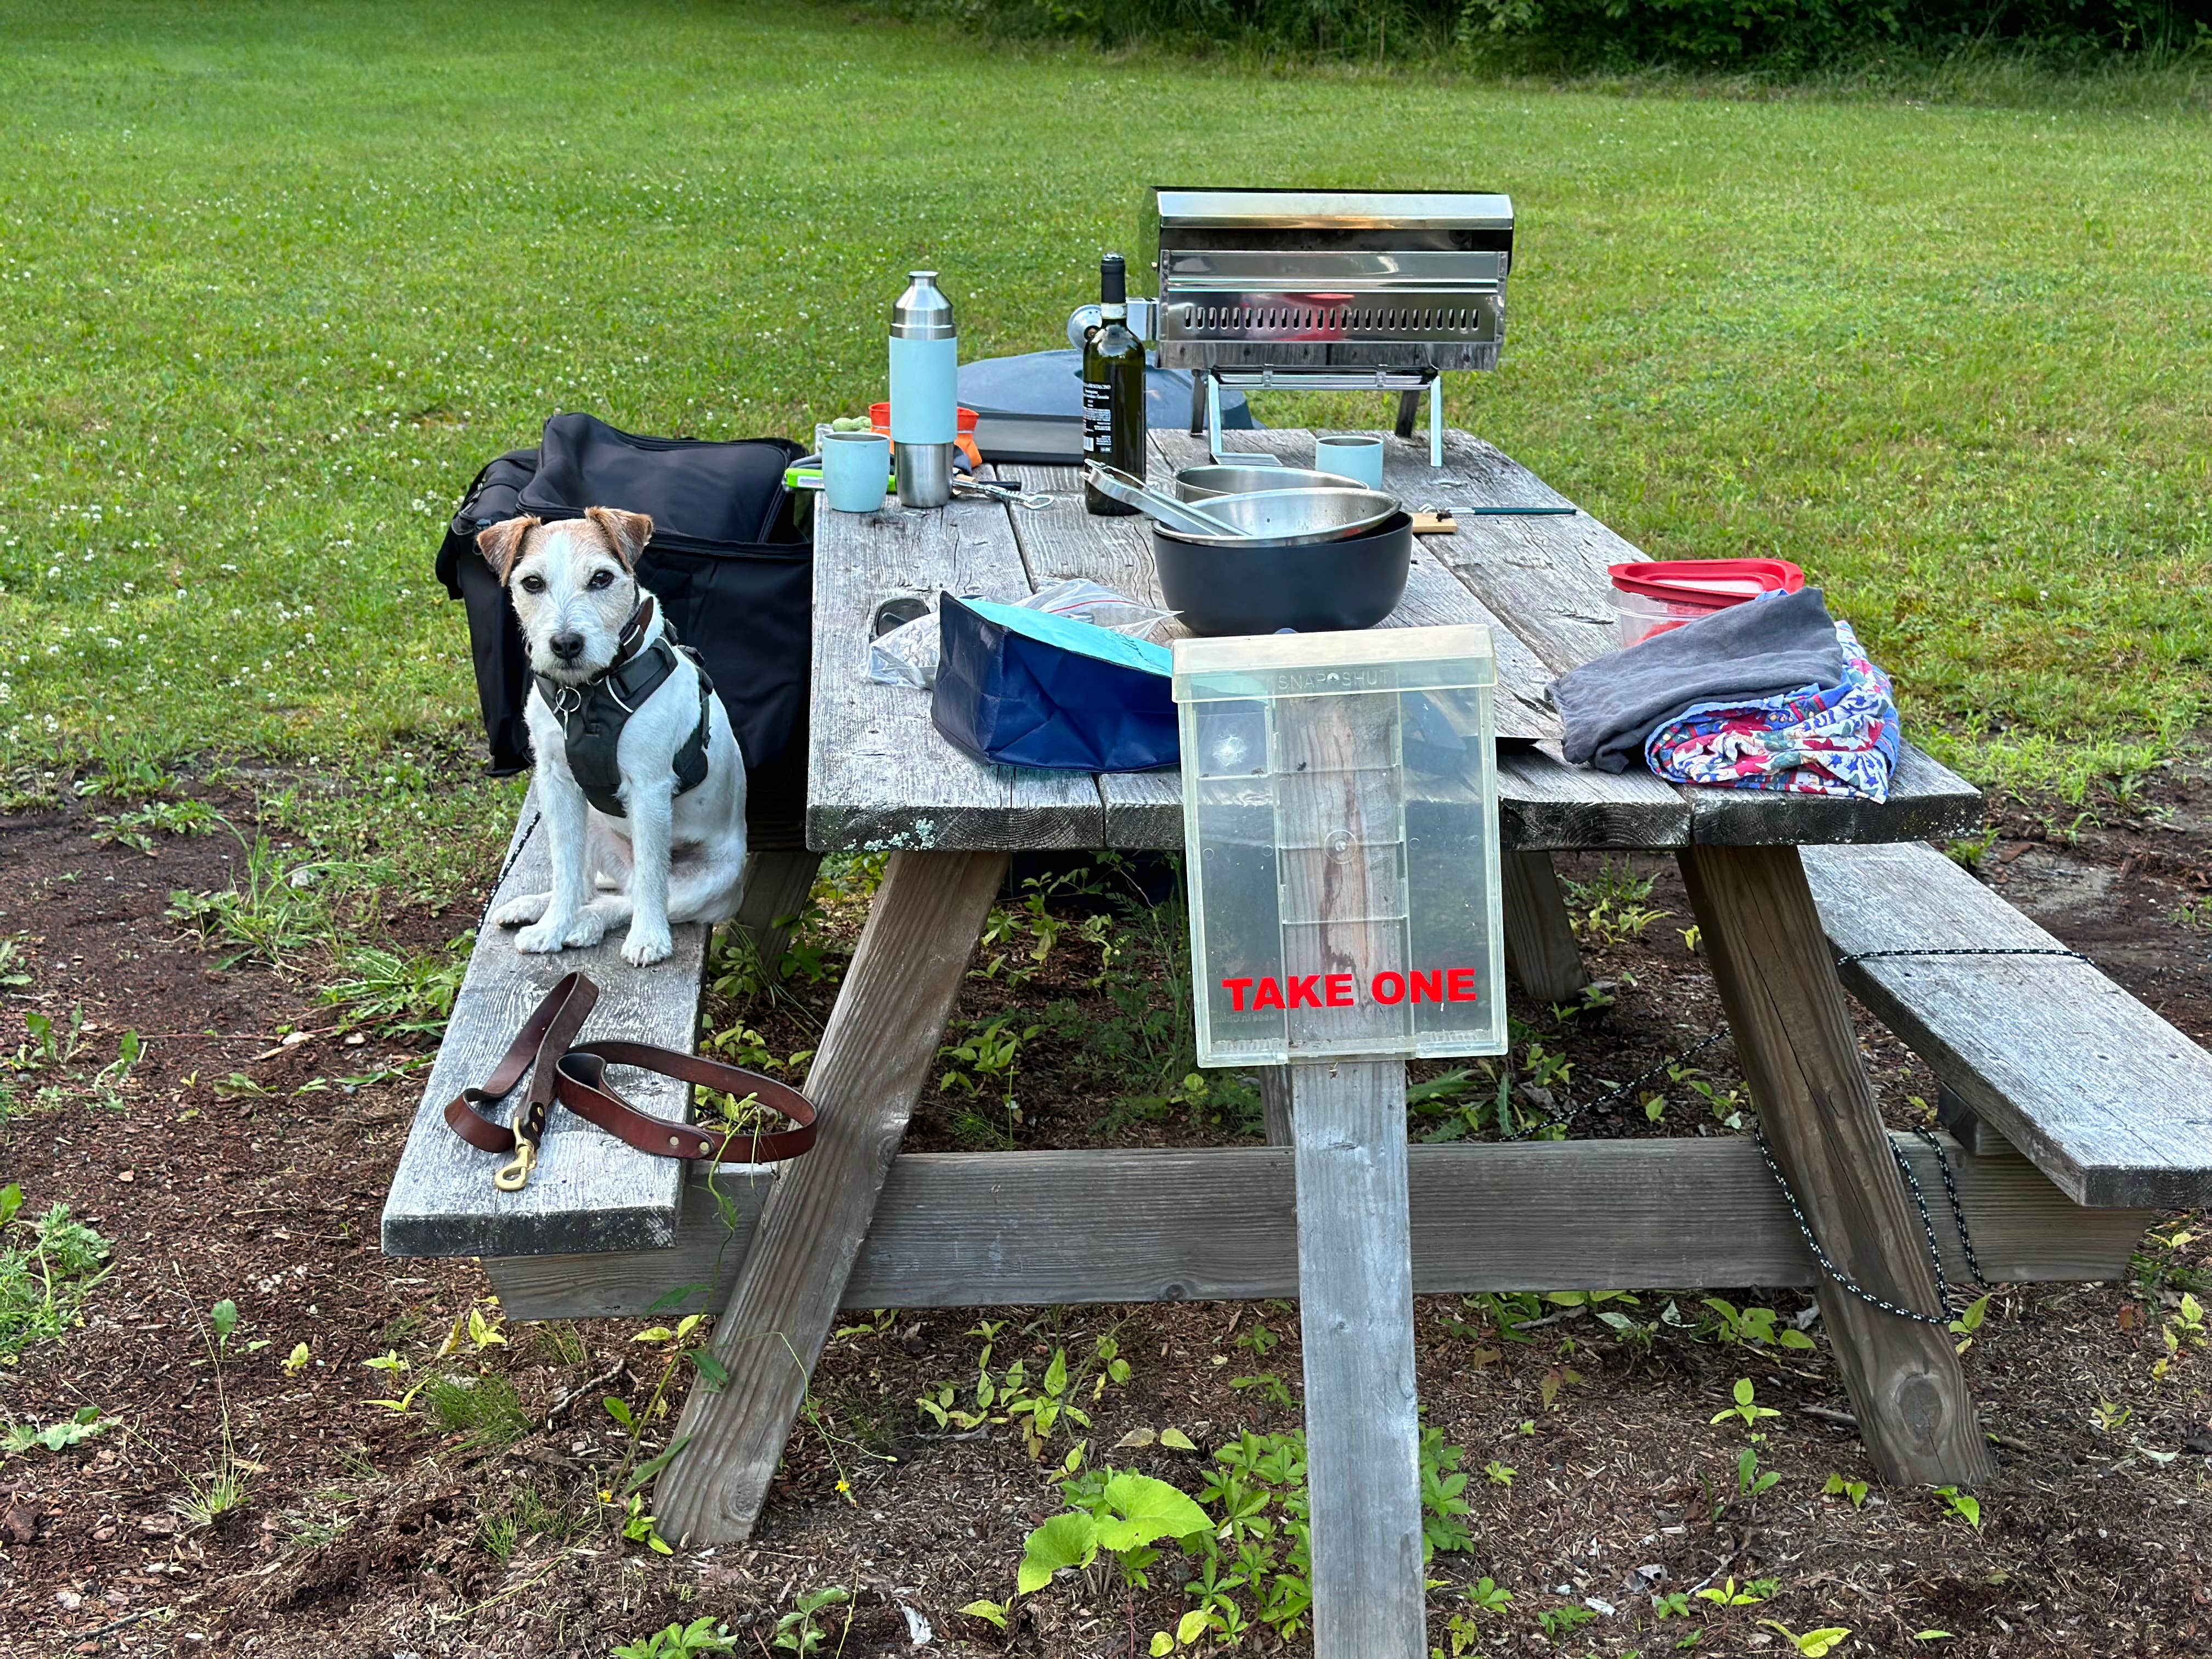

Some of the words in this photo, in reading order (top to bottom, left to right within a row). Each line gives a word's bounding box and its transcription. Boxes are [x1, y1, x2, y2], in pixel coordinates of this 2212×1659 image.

[1278, 673, 1326, 690] SNAP
[1342, 669, 1389, 686] SHUT
[1221, 974, 1355, 1011] TAKE
[1372, 968, 1477, 1006] ONE
